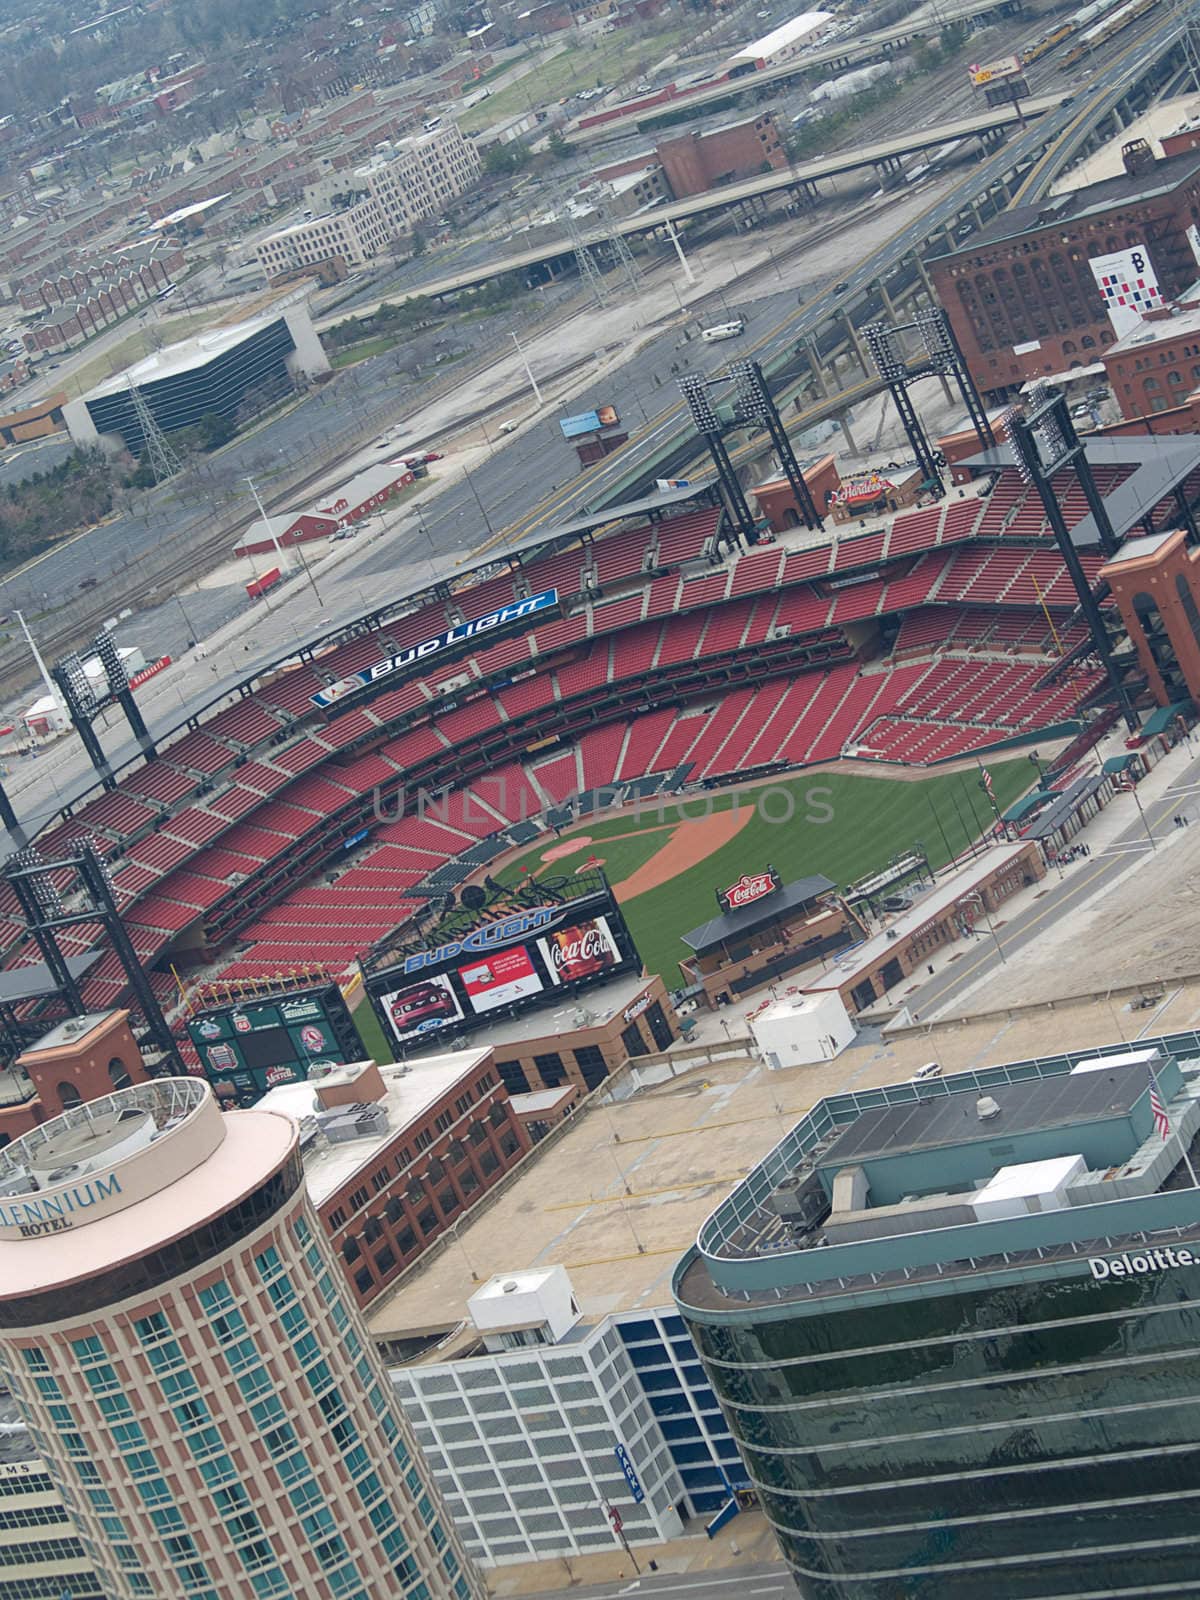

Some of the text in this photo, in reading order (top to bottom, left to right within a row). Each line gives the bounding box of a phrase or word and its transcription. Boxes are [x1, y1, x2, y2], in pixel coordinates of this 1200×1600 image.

[371, 596, 546, 680] BUD LIGHT
[404, 942, 463, 975] BUD
[480, 907, 558, 945] LIGHT
[550, 929, 613, 972] Coca-Cola
[0, 1173, 122, 1227] LENNIUM
[20, 1217, 73, 1237] HOTEL
[616, 1446, 638, 1489] PARK
